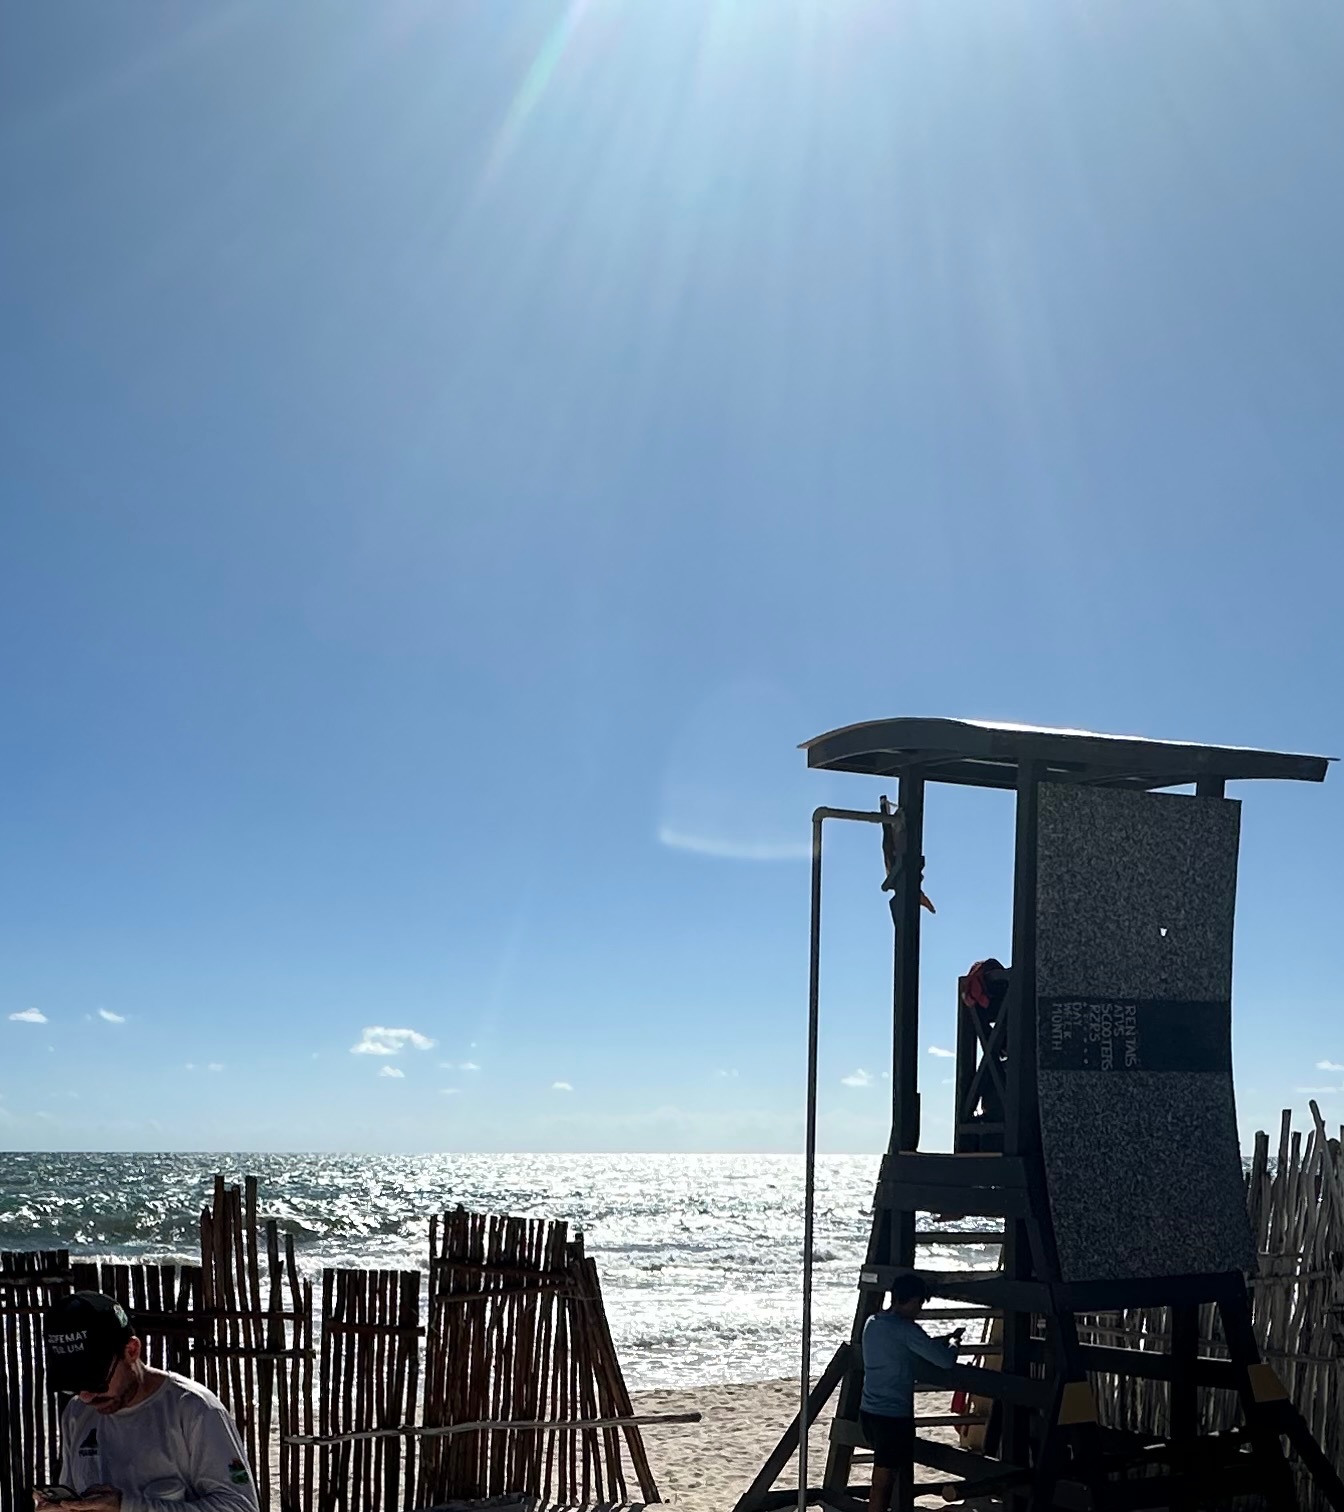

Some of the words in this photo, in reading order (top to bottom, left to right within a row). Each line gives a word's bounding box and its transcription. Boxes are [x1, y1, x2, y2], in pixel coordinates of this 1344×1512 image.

[1051, 1003, 1062, 1050] MONTH
[1072, 1002, 1082, 1026] DAY
[1101, 1004, 1113, 1071] SCOOTERS
[1125, 1005, 1137, 1067] RENTALS
